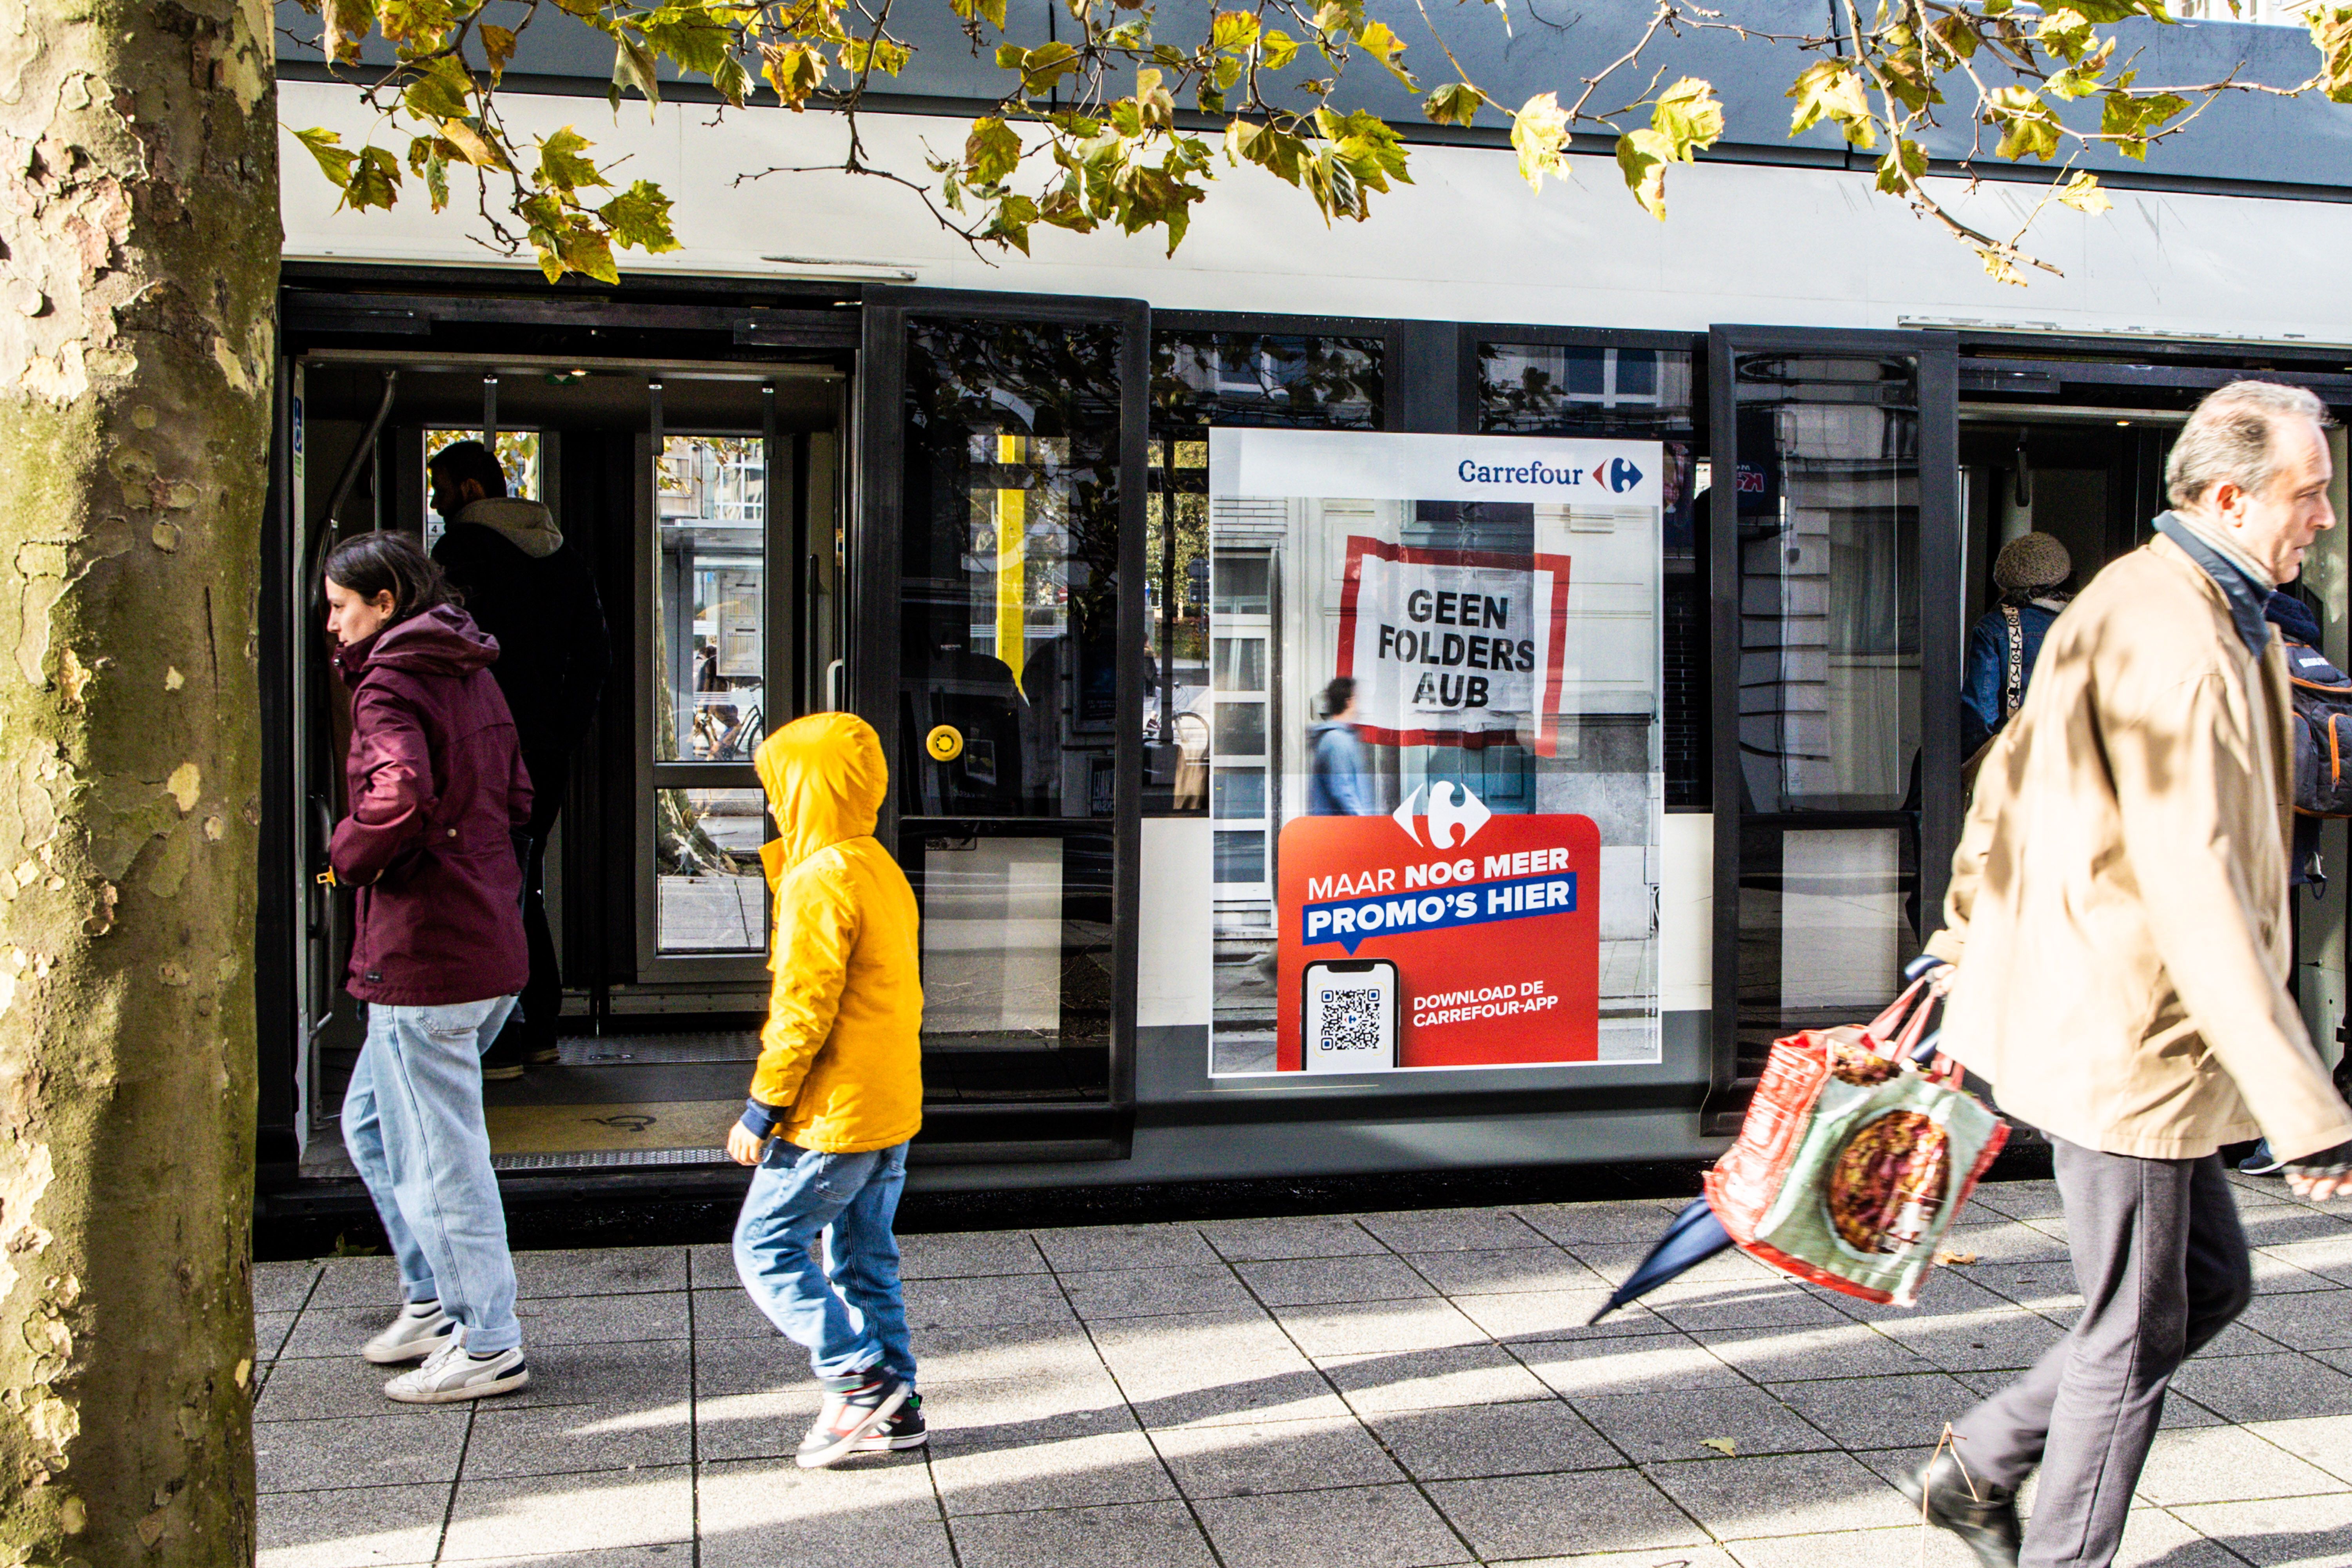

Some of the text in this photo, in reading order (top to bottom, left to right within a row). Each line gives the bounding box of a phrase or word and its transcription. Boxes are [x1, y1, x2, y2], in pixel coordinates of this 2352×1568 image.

[1458, 459, 1584, 485] Carrefour
[1407, 589, 1508, 630] GEEN
[1379, 624, 1535, 673] FOLDERS
[1411, 672, 1489, 708] AUB
[1308, 847, 1569, 901] MAAR NOG MEER
[1308, 880, 1570, 937] PROMO'S HIER
[1413, 995, 1559, 1027] CARREFOUR-APP
[1414, 980, 1544, 1011] DOWNLOAD DE
